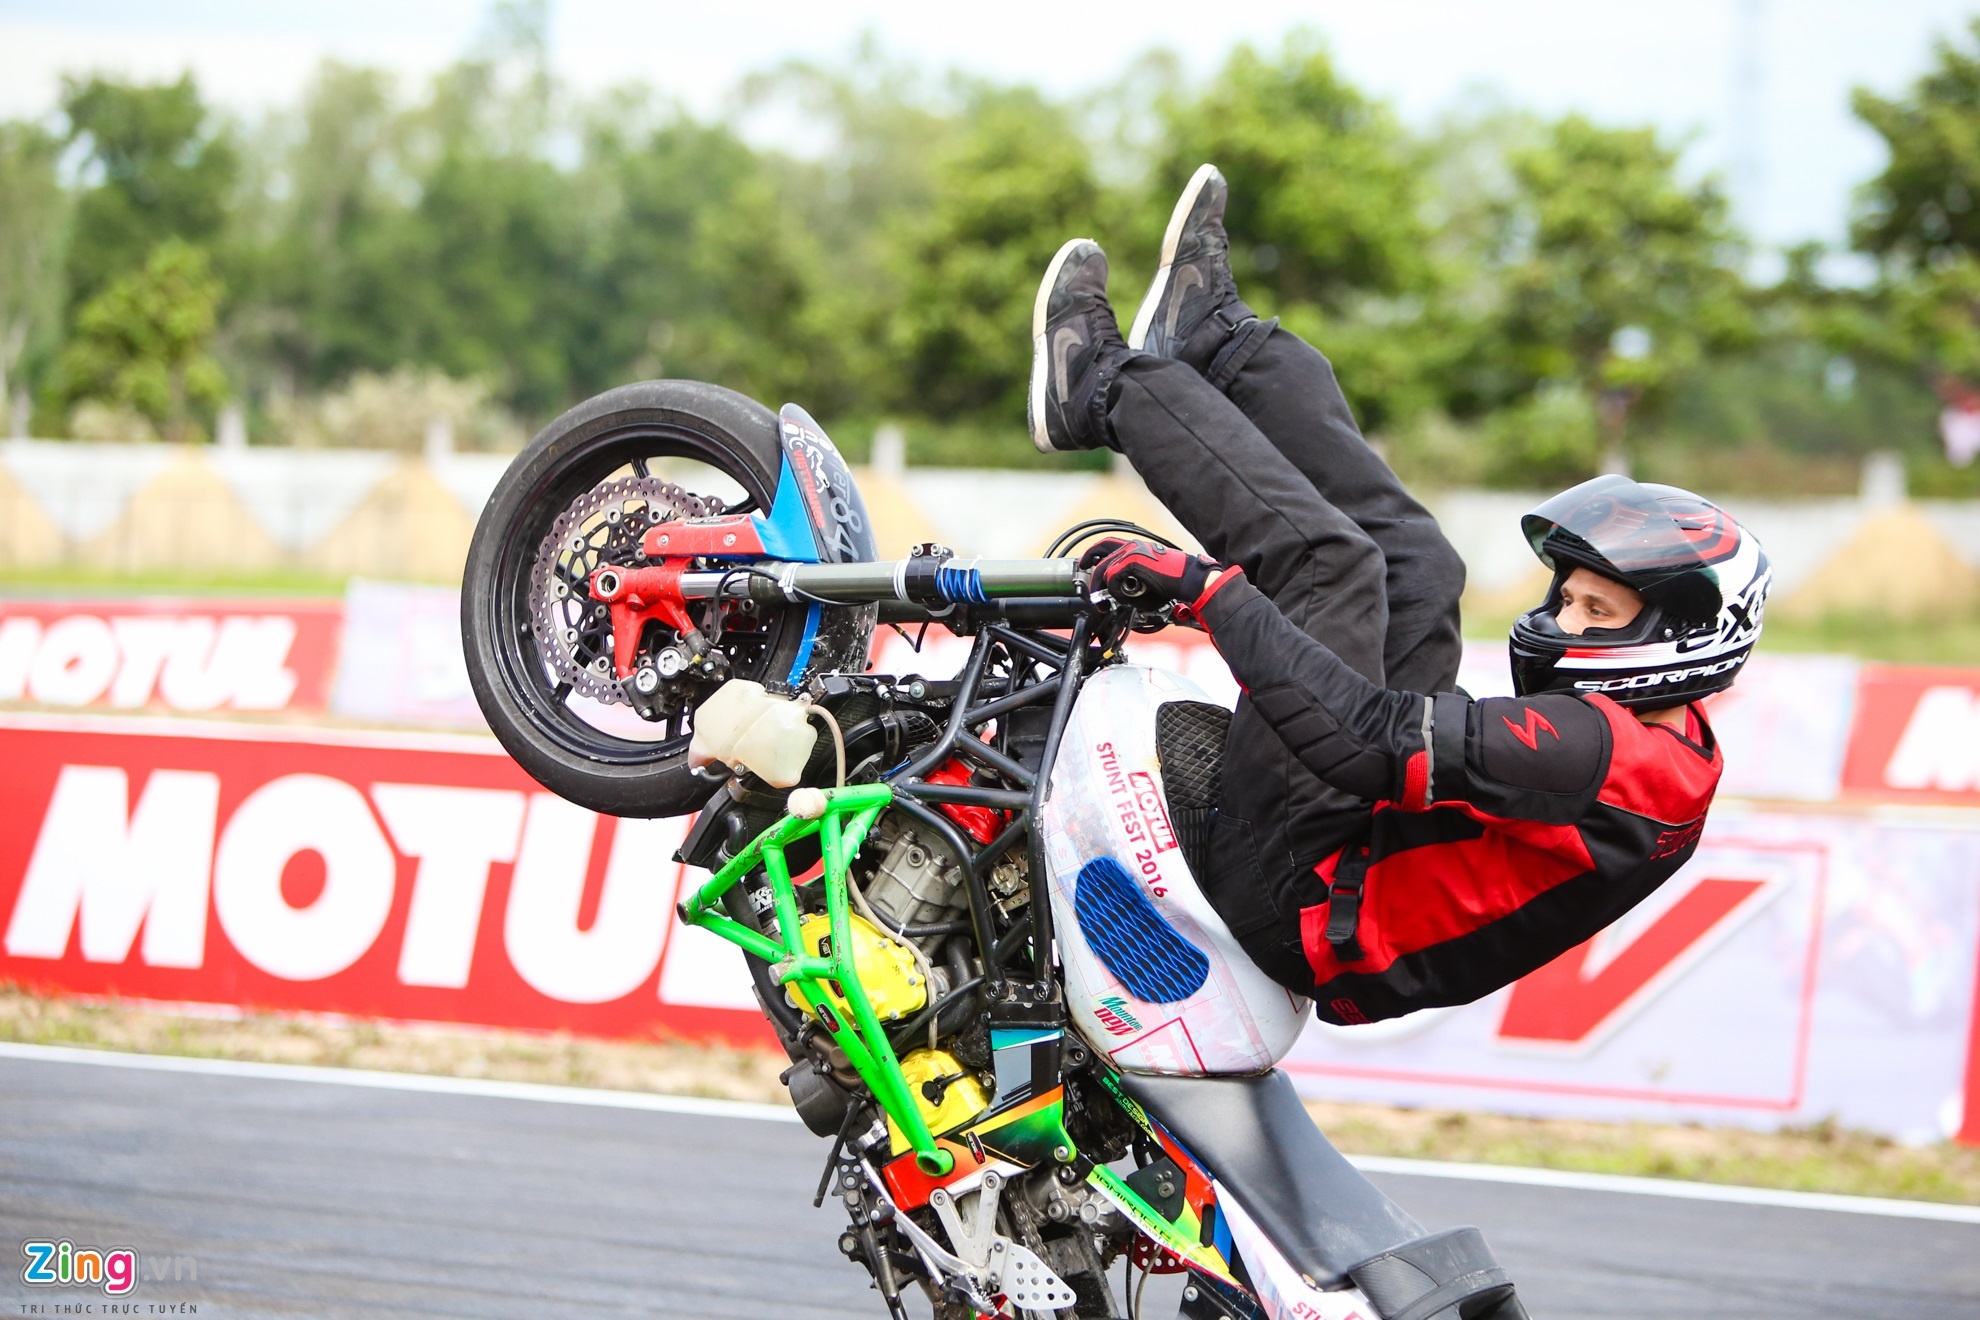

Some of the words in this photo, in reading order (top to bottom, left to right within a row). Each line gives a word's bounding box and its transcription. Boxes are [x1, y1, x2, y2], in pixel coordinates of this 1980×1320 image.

[1574, 651, 1749, 692] SCORPION
[1096, 742, 1127, 796] STUNT
[1116, 804, 1145, 844] FEST
[1135, 851, 1166, 899] 2016
[1128, 771, 1178, 854] MOTUL
